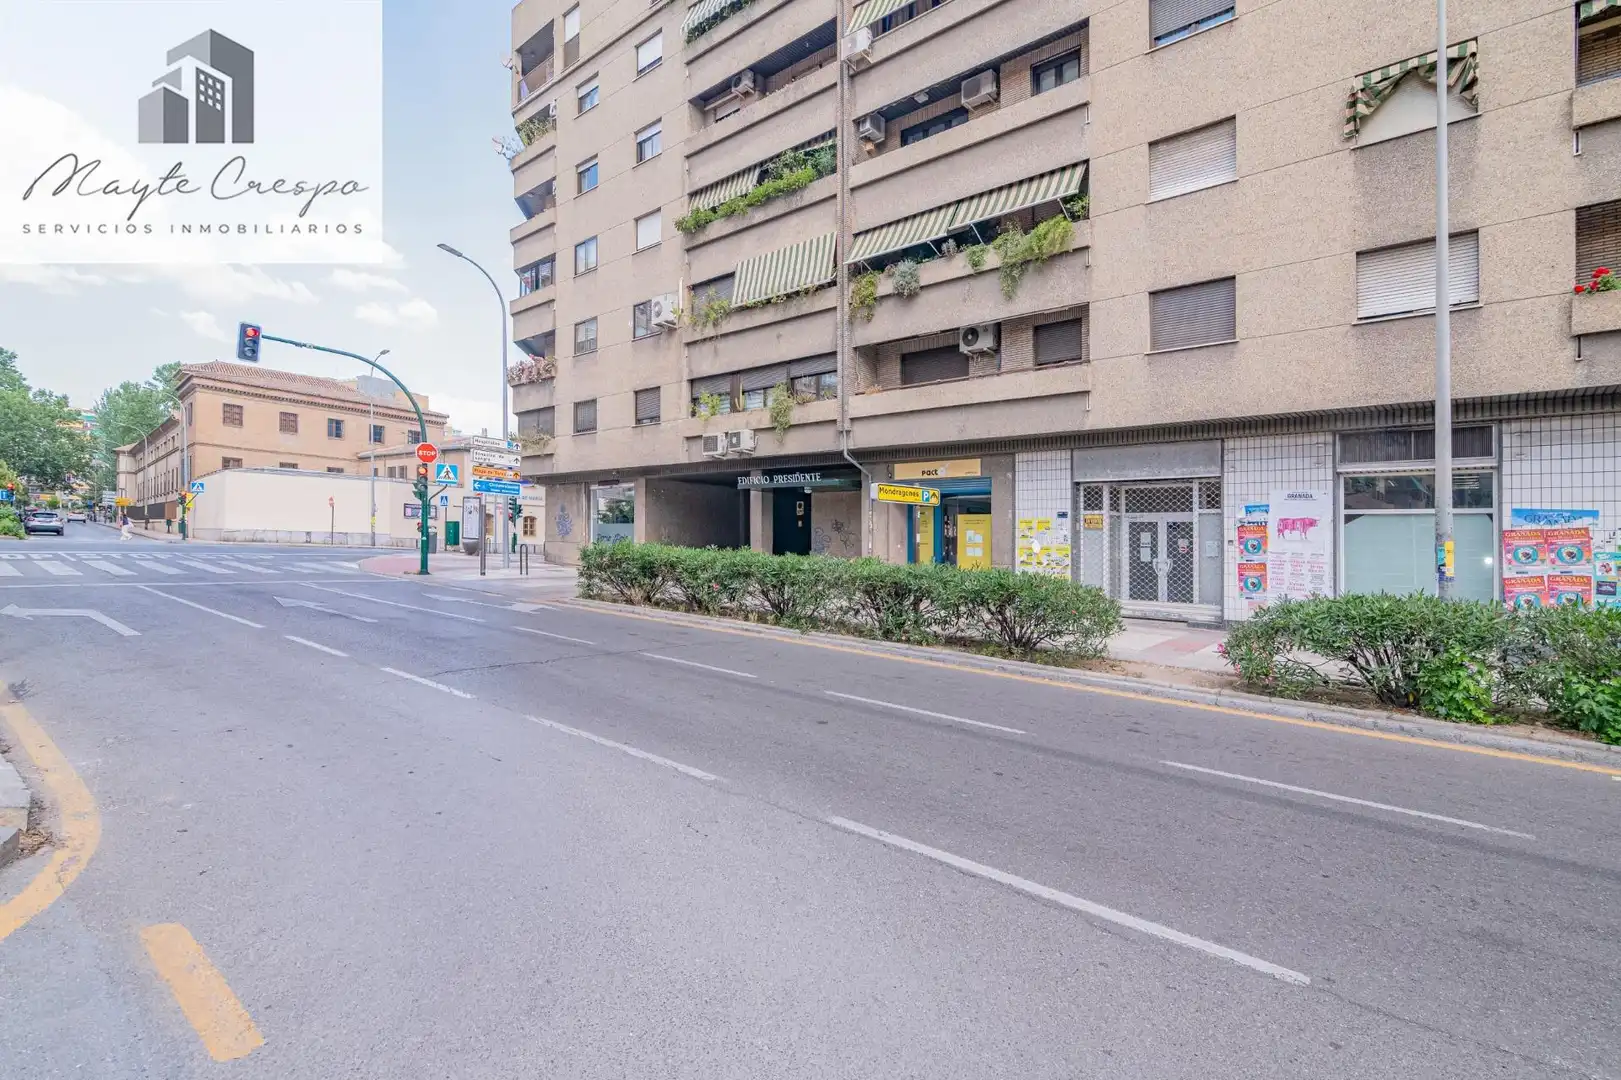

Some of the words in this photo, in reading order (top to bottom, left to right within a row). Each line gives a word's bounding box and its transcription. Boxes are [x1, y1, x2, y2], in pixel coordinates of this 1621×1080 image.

[737, 475, 770, 485] EDIFICIO
[773, 472, 822, 484] PRESIDENTE
[879, 487, 920, 498] Mondragones
[1547, 529, 1586, 537] GRANADA
